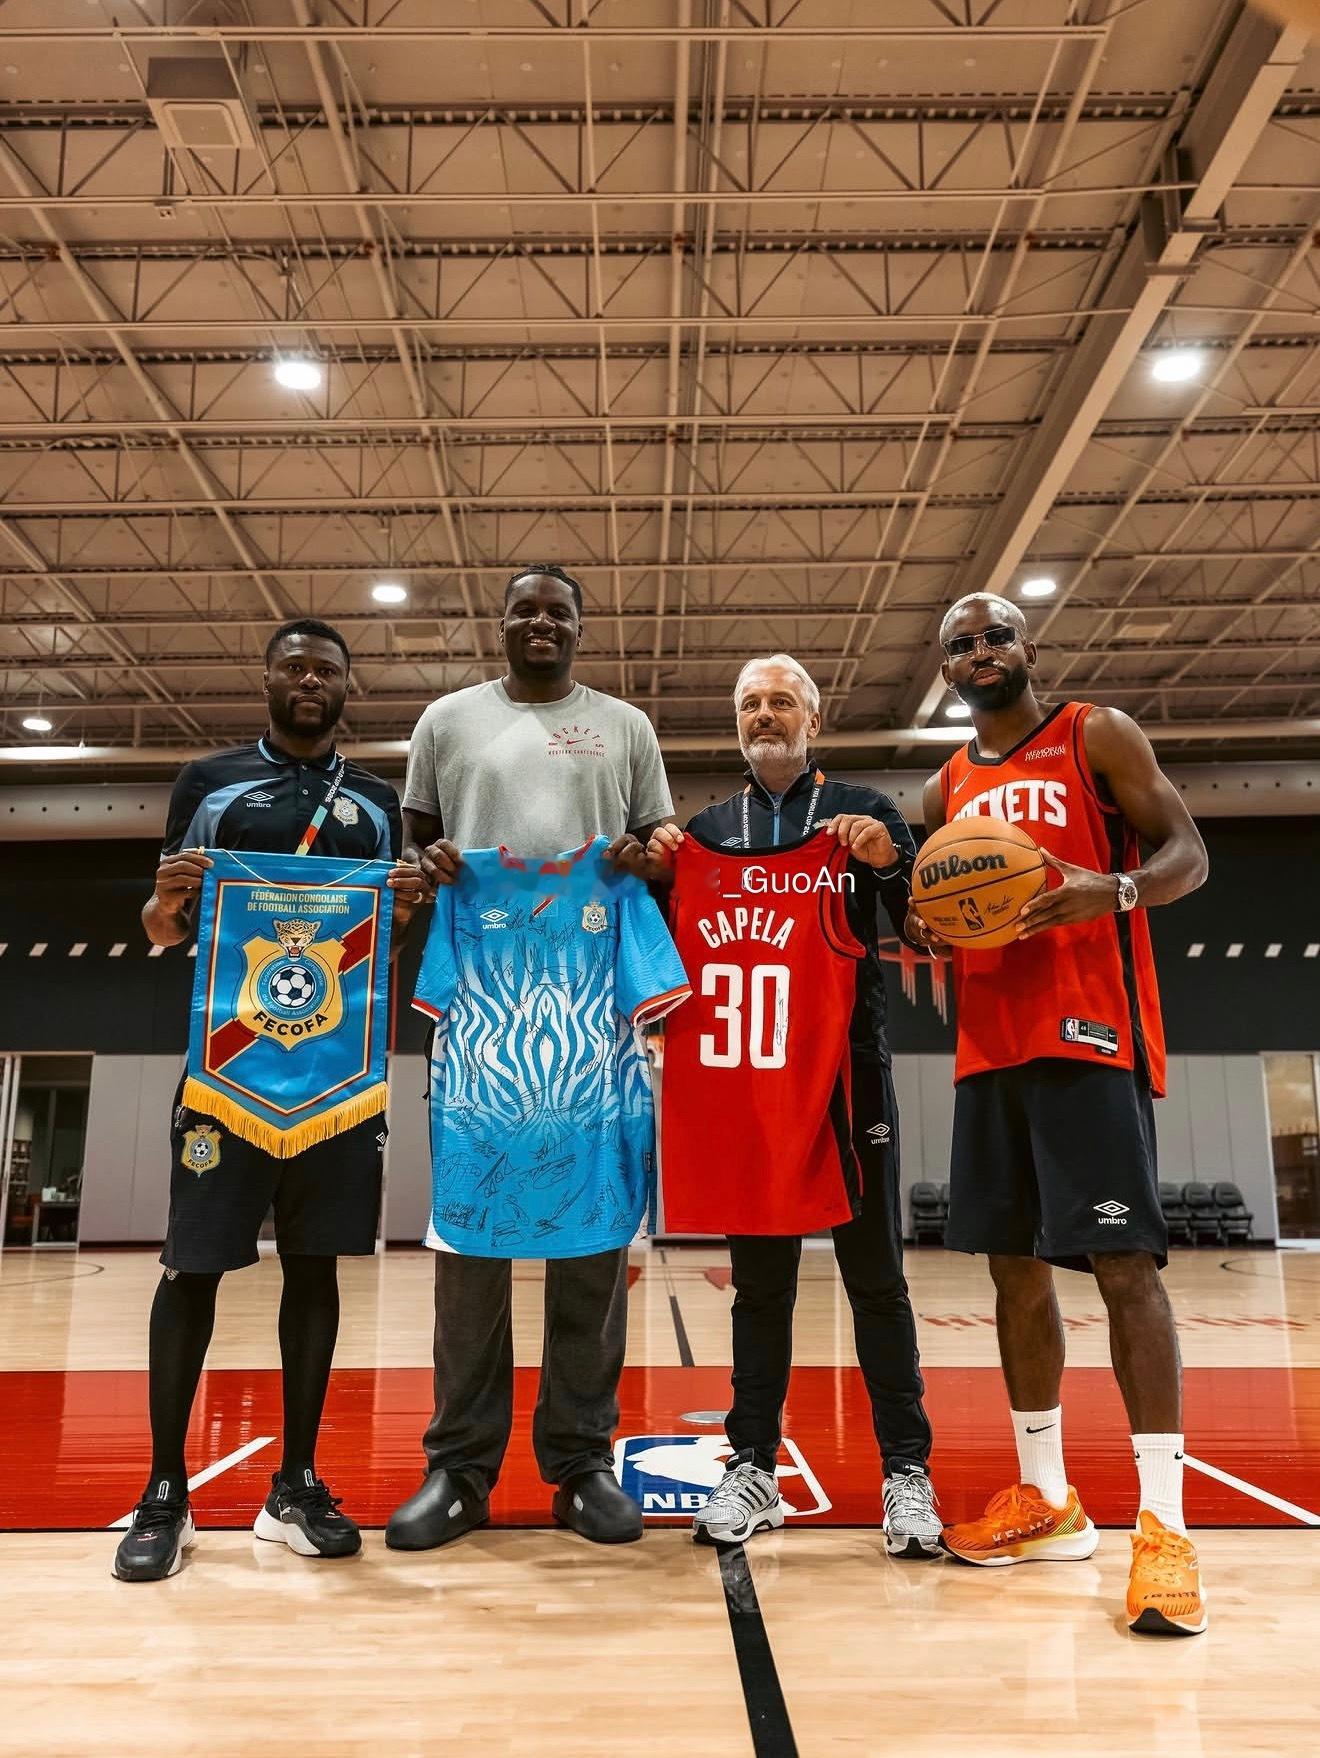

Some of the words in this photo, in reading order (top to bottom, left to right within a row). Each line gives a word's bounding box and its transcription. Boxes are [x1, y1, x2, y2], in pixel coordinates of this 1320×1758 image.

[920, 855, 1008, 889] Wilson
[251, 889, 298, 902] FÉDÉRATION
[299, 893, 348, 904] CONGOLAISE
[247, 902, 258, 912] DE
[258, 902, 298, 914] FOOTBALL
[297, 904, 350, 915] ASSOCIATION
[482, 922, 507, 930] umbro
[698, 907, 795, 950] CAPELA
[253, 1010, 328, 1036] FECOFA
[700, 963, 791, 1069] 30
[1098, 1216, 1127, 1225] umbro
[643, 1493, 708, 1509] NB
